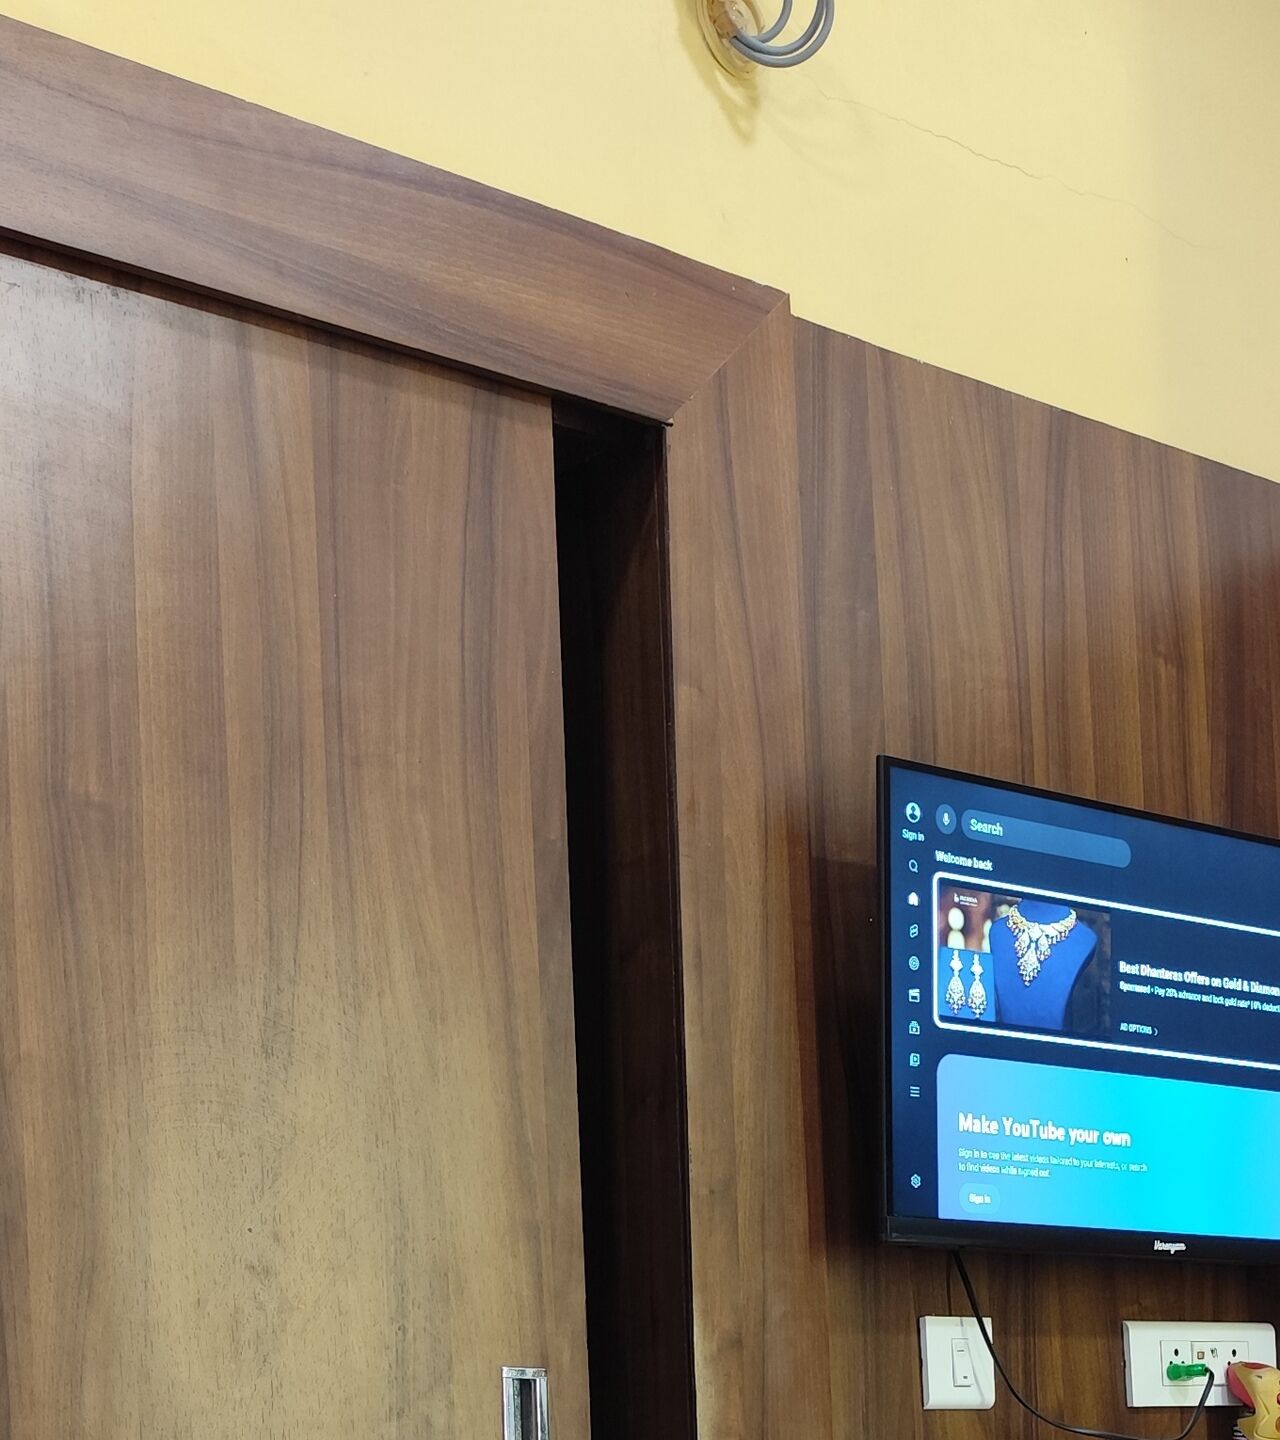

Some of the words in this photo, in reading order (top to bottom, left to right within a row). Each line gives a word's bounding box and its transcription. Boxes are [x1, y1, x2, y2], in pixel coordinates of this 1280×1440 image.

[902, 828, 917, 842] Sign
[918, 831, 925, 842] in
[970, 819, 1004, 837] Search
[935, 849, 972, 868] Welcome
[973, 857, 994, 871] back
[1120, 960, 1139, 975] Best
[1140, 964, 1183, 982] Dhanteras
[1183, 971, 1210, 986] Offers
[1211, 976, 1222, 988] on
[1223, 977, 1242, 991] Gold
[1243, 980, 1250, 992] &
[1154, 985, 1166, 998] Pay
[1202, 994, 1212, 1003] and
[1213, 994, 1224, 1005] lock
[1224, 998, 1237, 1007] gold
[958, 1111, 999, 1136] Make
[1001, 1116, 1065, 1142] YouTube
[1069, 1127, 1100, 1147] your
[1103, 1130, 1132, 1147] own
[959, 1147, 973, 1159] Sign
[973, 1148, 980, 1158] in
[1000, 1151, 1011, 1161] the
[1011, 1151, 1029, 1162] latest
[1050, 1155, 1073, 1166] tailored
[1073, 1157, 1080, 1167] to
[1080, 1159, 1094, 1169] your
[959, 1161, 966, 1172] to
[966, 1161, 980, 1173] find
[968, 1193, 984, 1205] Sign
[984, 1194, 992, 1204] in
